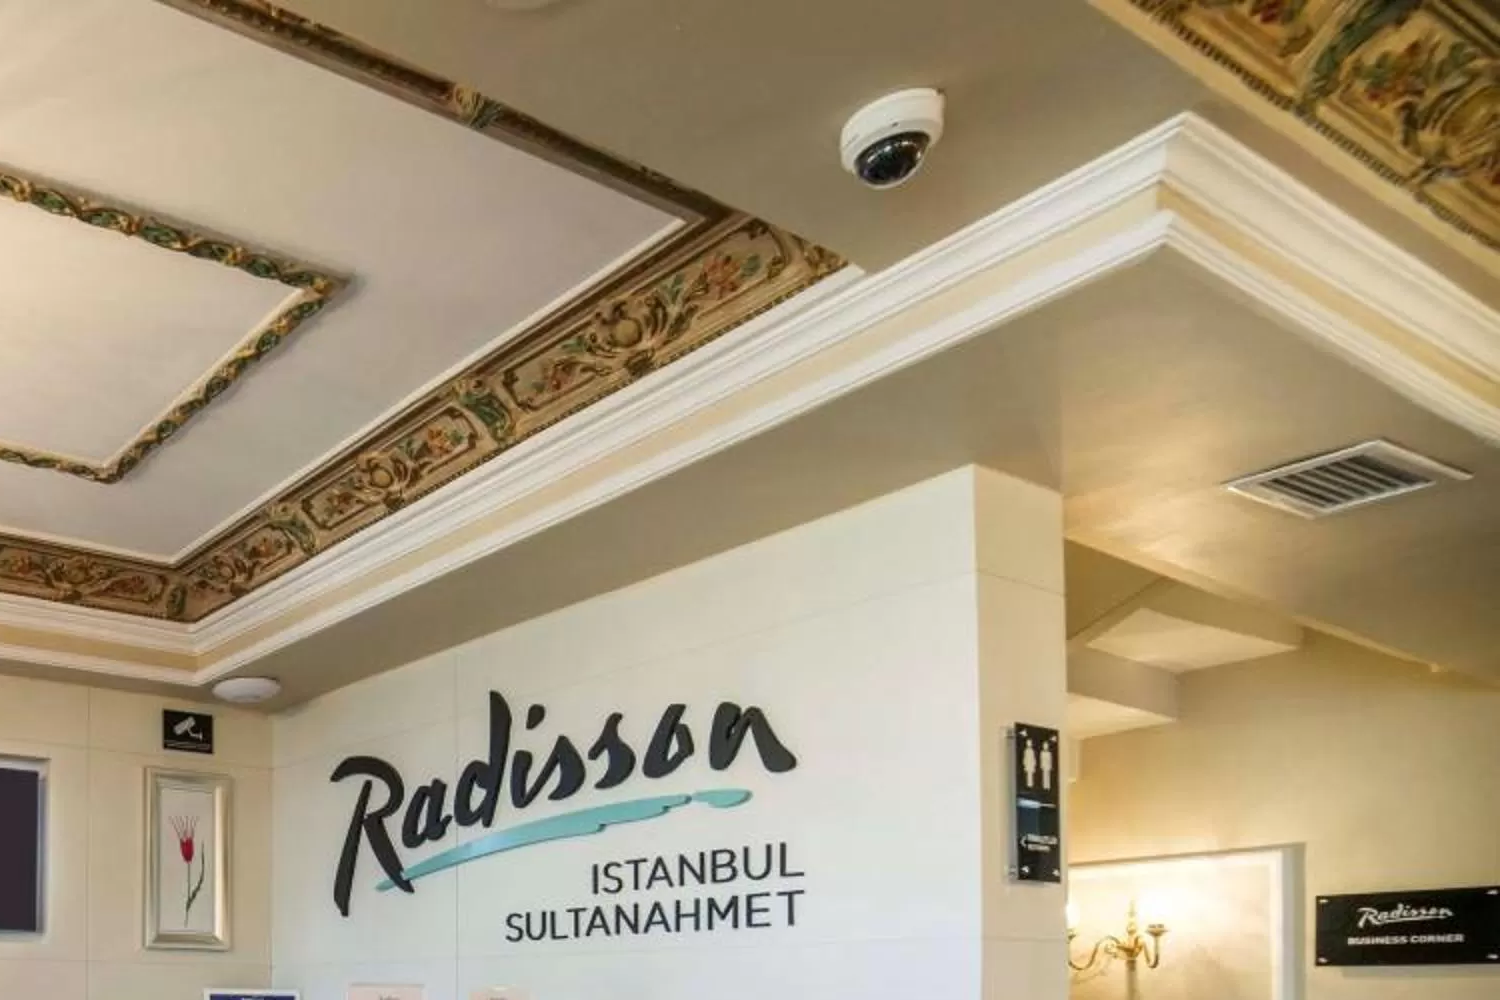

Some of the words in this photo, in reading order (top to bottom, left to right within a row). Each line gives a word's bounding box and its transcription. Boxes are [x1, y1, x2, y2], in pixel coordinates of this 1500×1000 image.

[330, 690, 798, 917] Radisson
[592, 842, 806, 894] ISTANBUL
[505, 890, 806, 943] SULTANAHMET
[1347, 935, 1408, 946] BUSINESS
[1411, 933, 1465, 944] CORNER
[1357, 903, 1454, 928] Radisson
